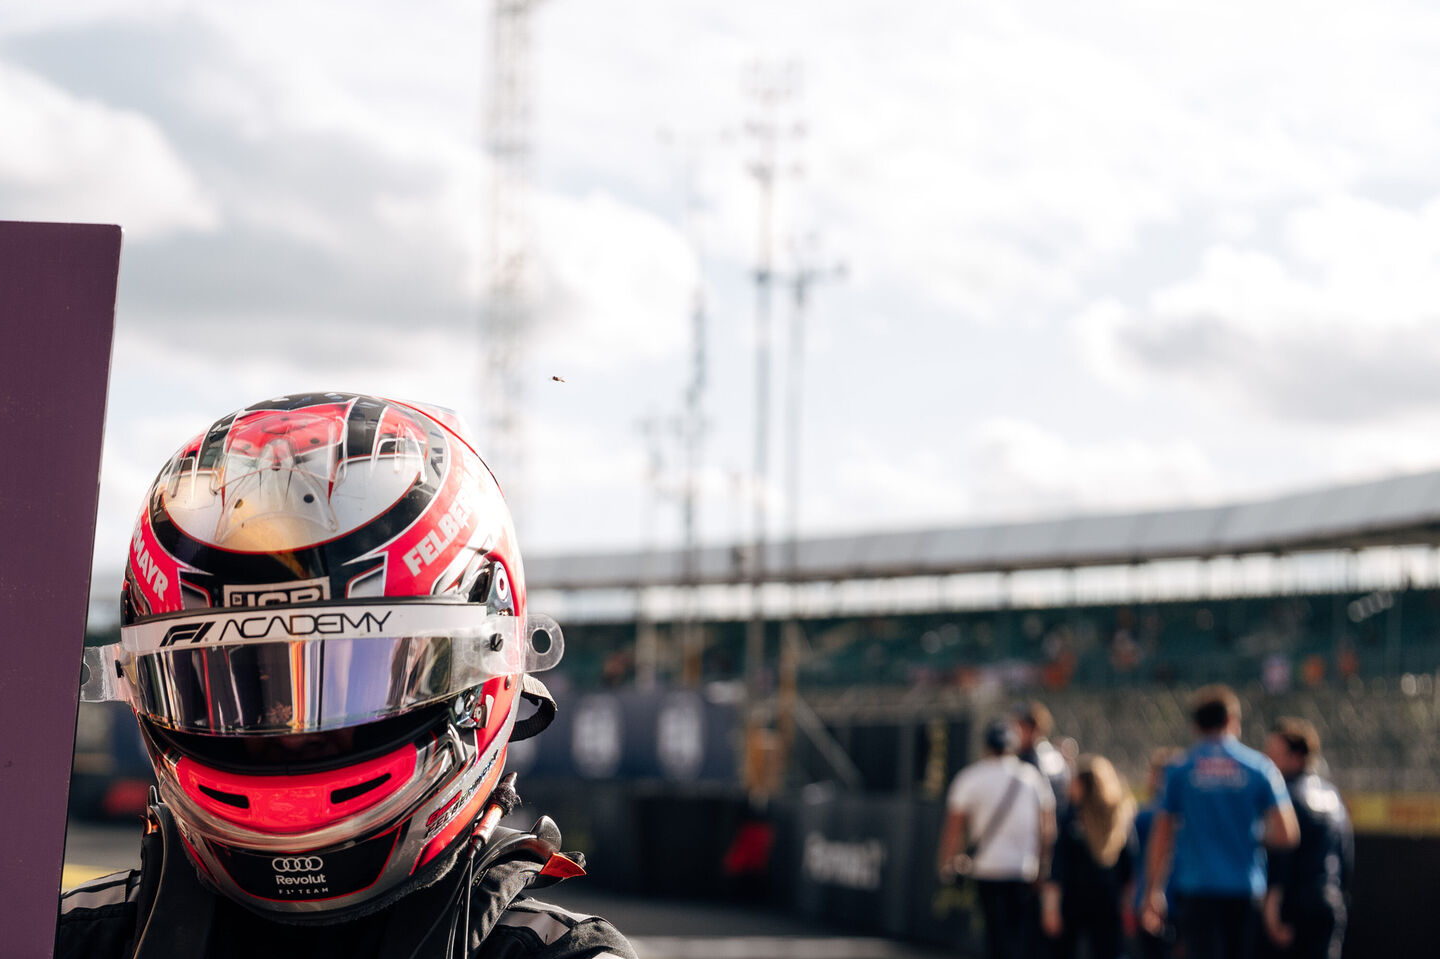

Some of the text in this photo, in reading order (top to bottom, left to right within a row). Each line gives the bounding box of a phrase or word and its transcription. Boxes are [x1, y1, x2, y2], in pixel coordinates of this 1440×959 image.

[219, 610, 392, 641] ACADEMY
[275, 873, 327, 885] Revolut
[298, 887, 329, 895] TEAM
